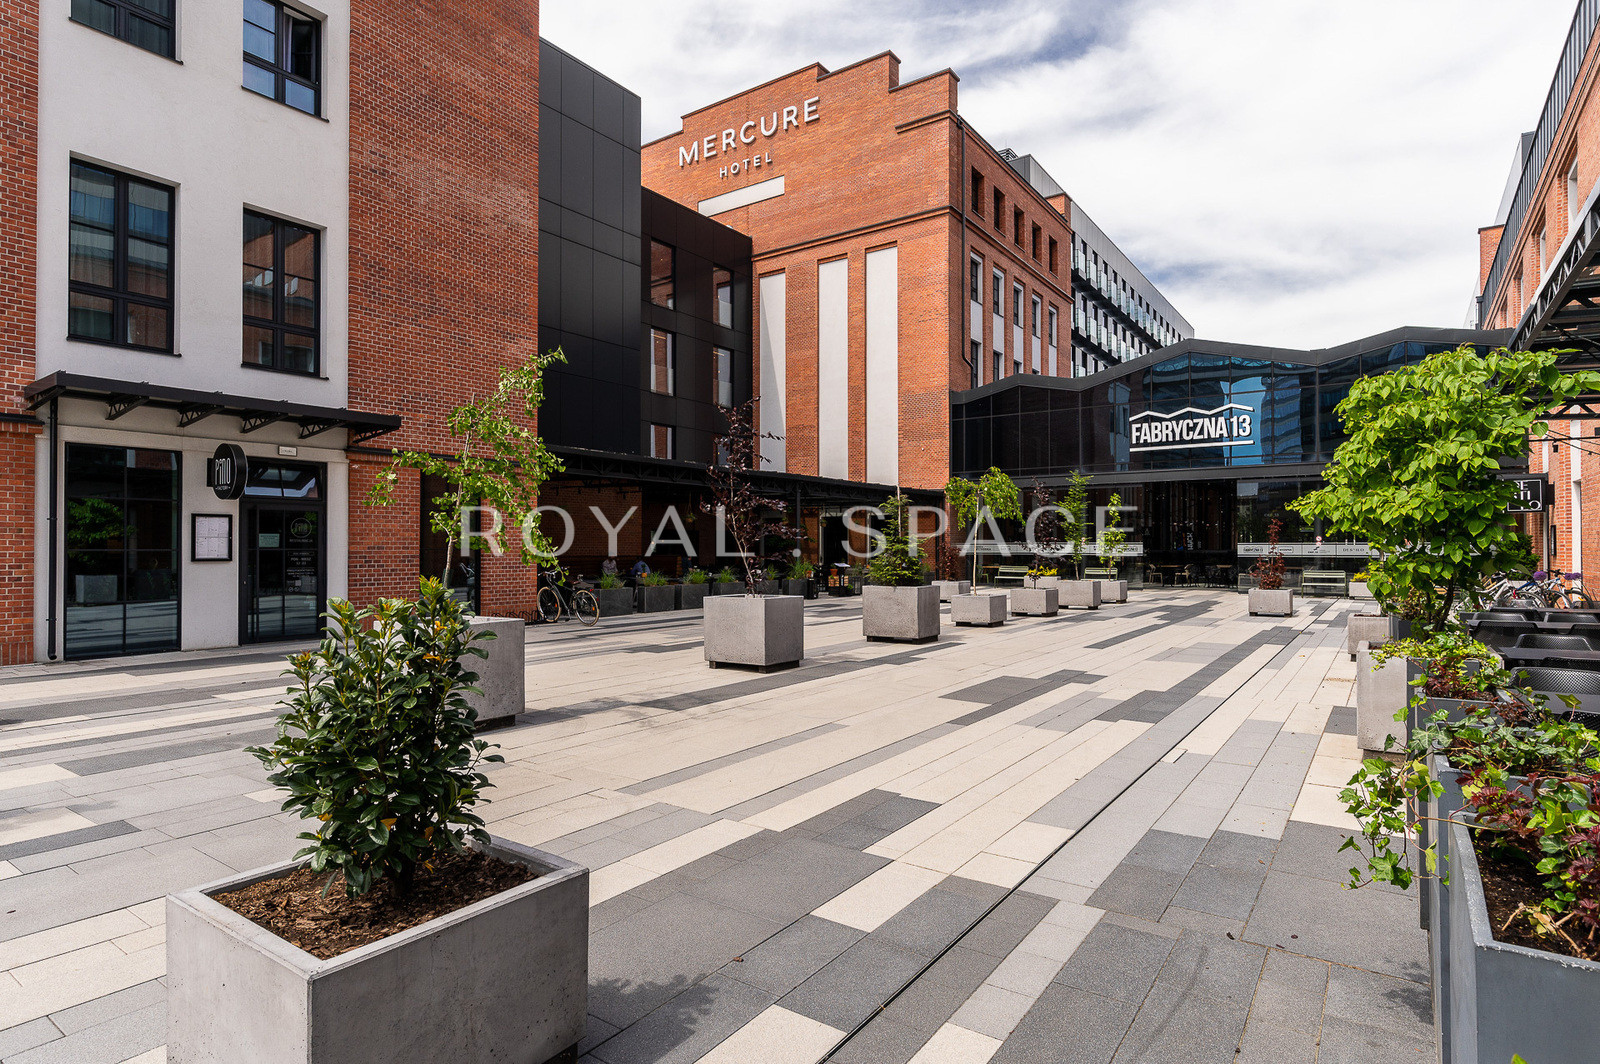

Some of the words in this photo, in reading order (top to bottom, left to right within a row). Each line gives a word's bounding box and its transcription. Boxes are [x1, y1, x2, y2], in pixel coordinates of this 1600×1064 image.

[679, 96, 821, 167] MERCURE
[719, 152, 773, 179] HOTEL
[1131, 417, 1229, 444] FABRYCZNA
[1230, 414, 1252, 438] 13
